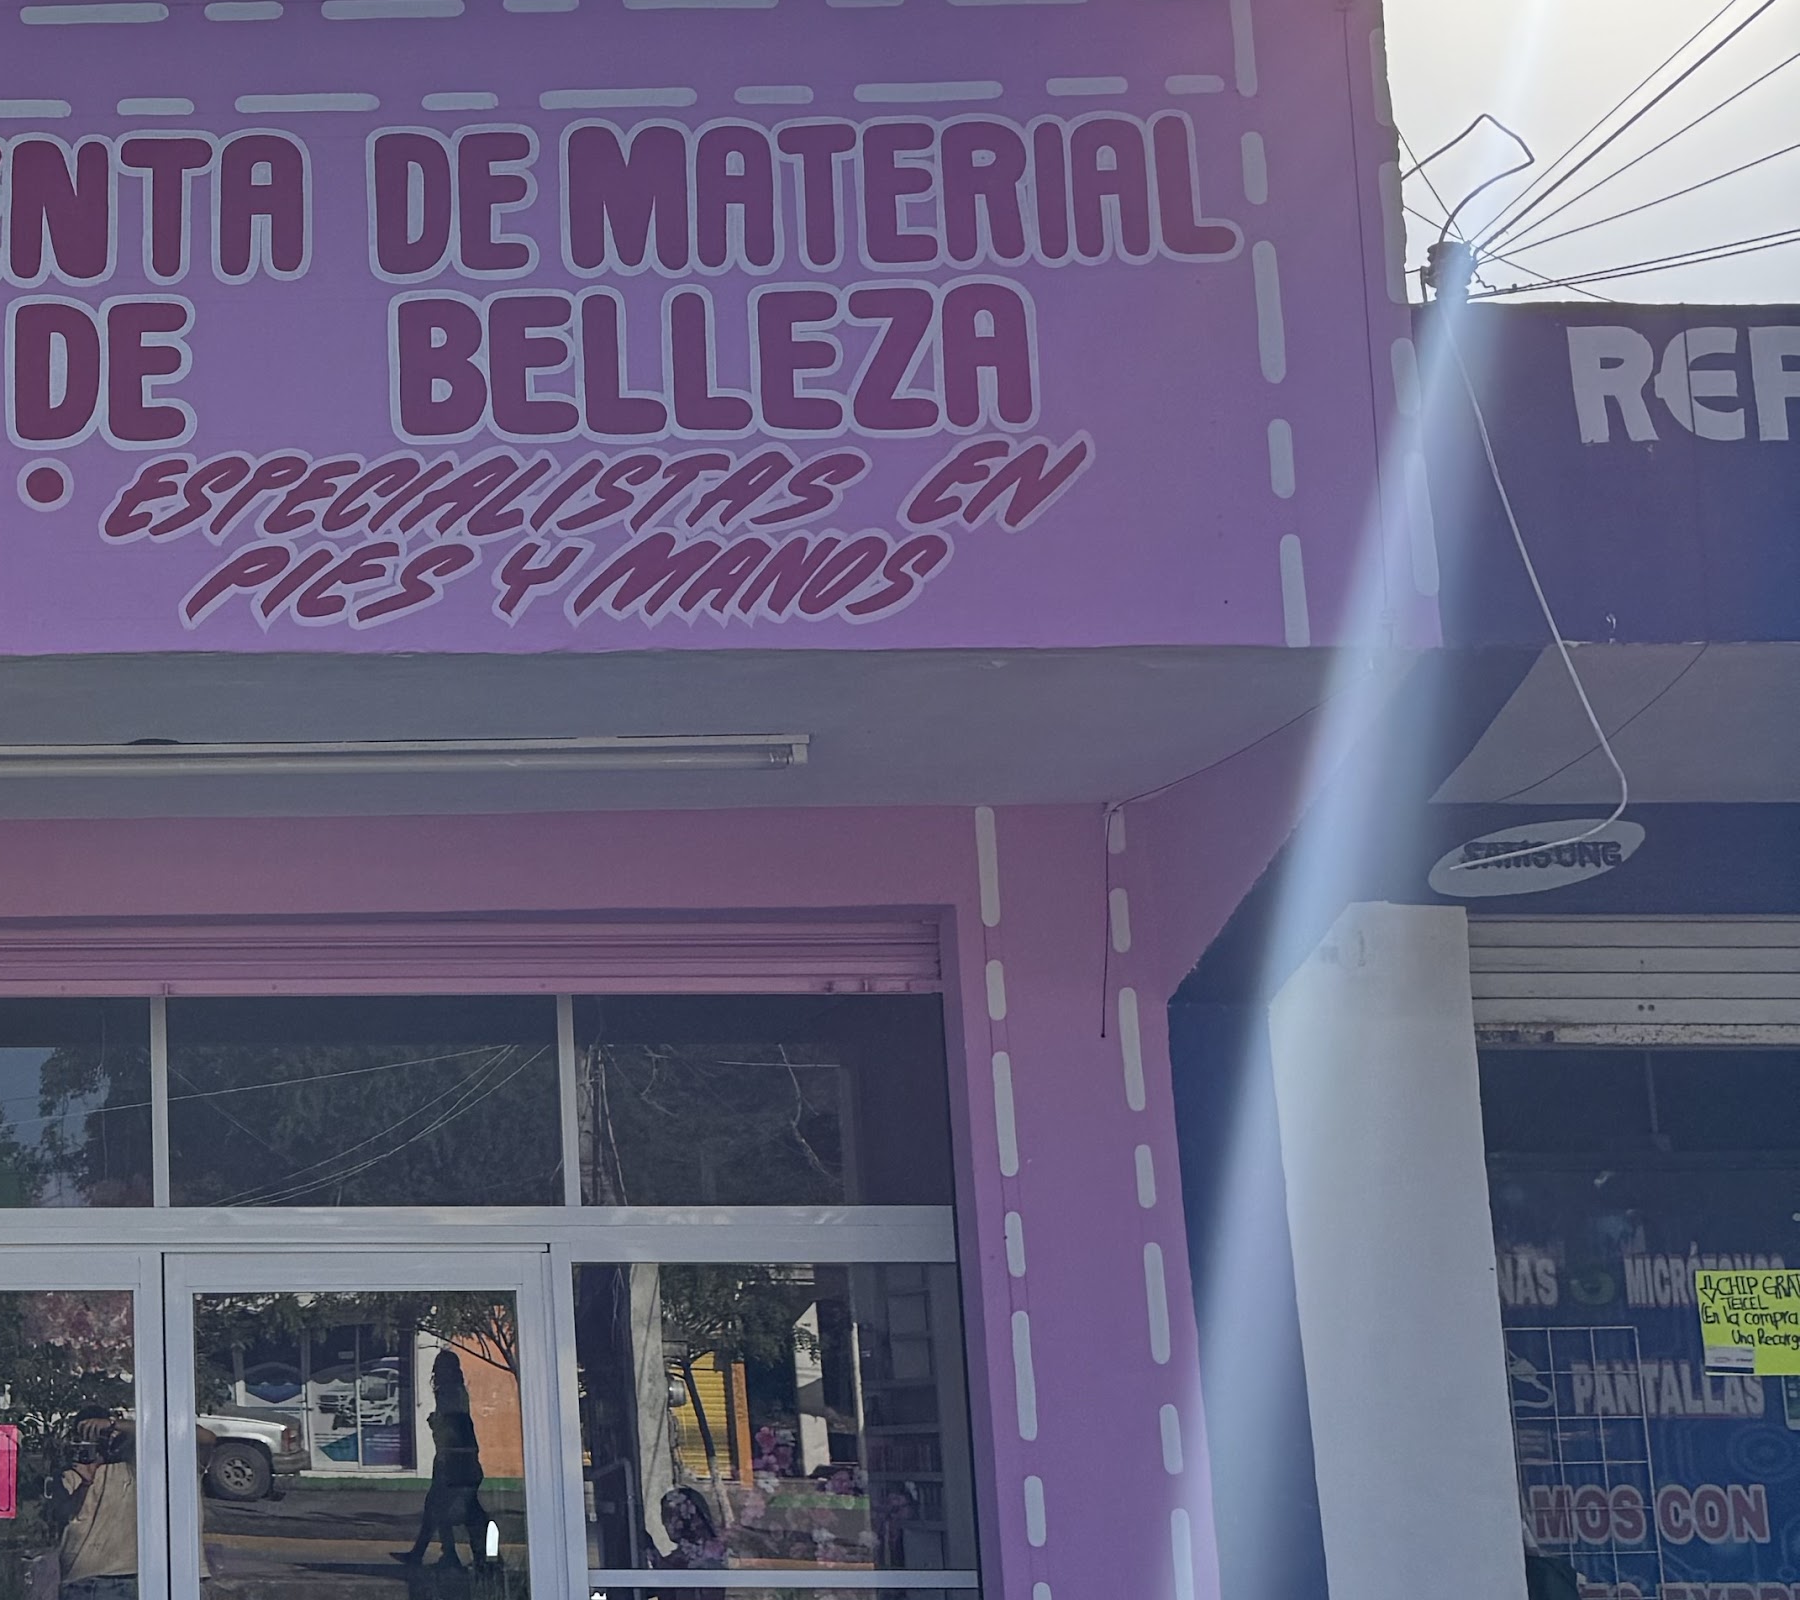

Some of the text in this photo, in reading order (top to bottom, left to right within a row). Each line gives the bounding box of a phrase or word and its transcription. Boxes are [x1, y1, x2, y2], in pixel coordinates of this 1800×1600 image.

[365, 123, 541, 284] DE
[560, 109, 1245, 279] MATERIAL
[4, 274, 1041, 451] DE BELLEZA
[99, 429, 1096, 546] ESPECIALISTAS EN
[178, 528, 956, 634] PIES Y MANOS
[1461, 839, 1622, 870] SAMSUNG
[1716, 1275, 1759, 1297] CHIP
[1744, 1310, 1799, 1330] compra
[1757, 1327, 1800, 1351] Recarg
[1571, 1359, 1766, 1417] PANTALLAS
[1528, 1483, 1771, 1545] MOS CON
